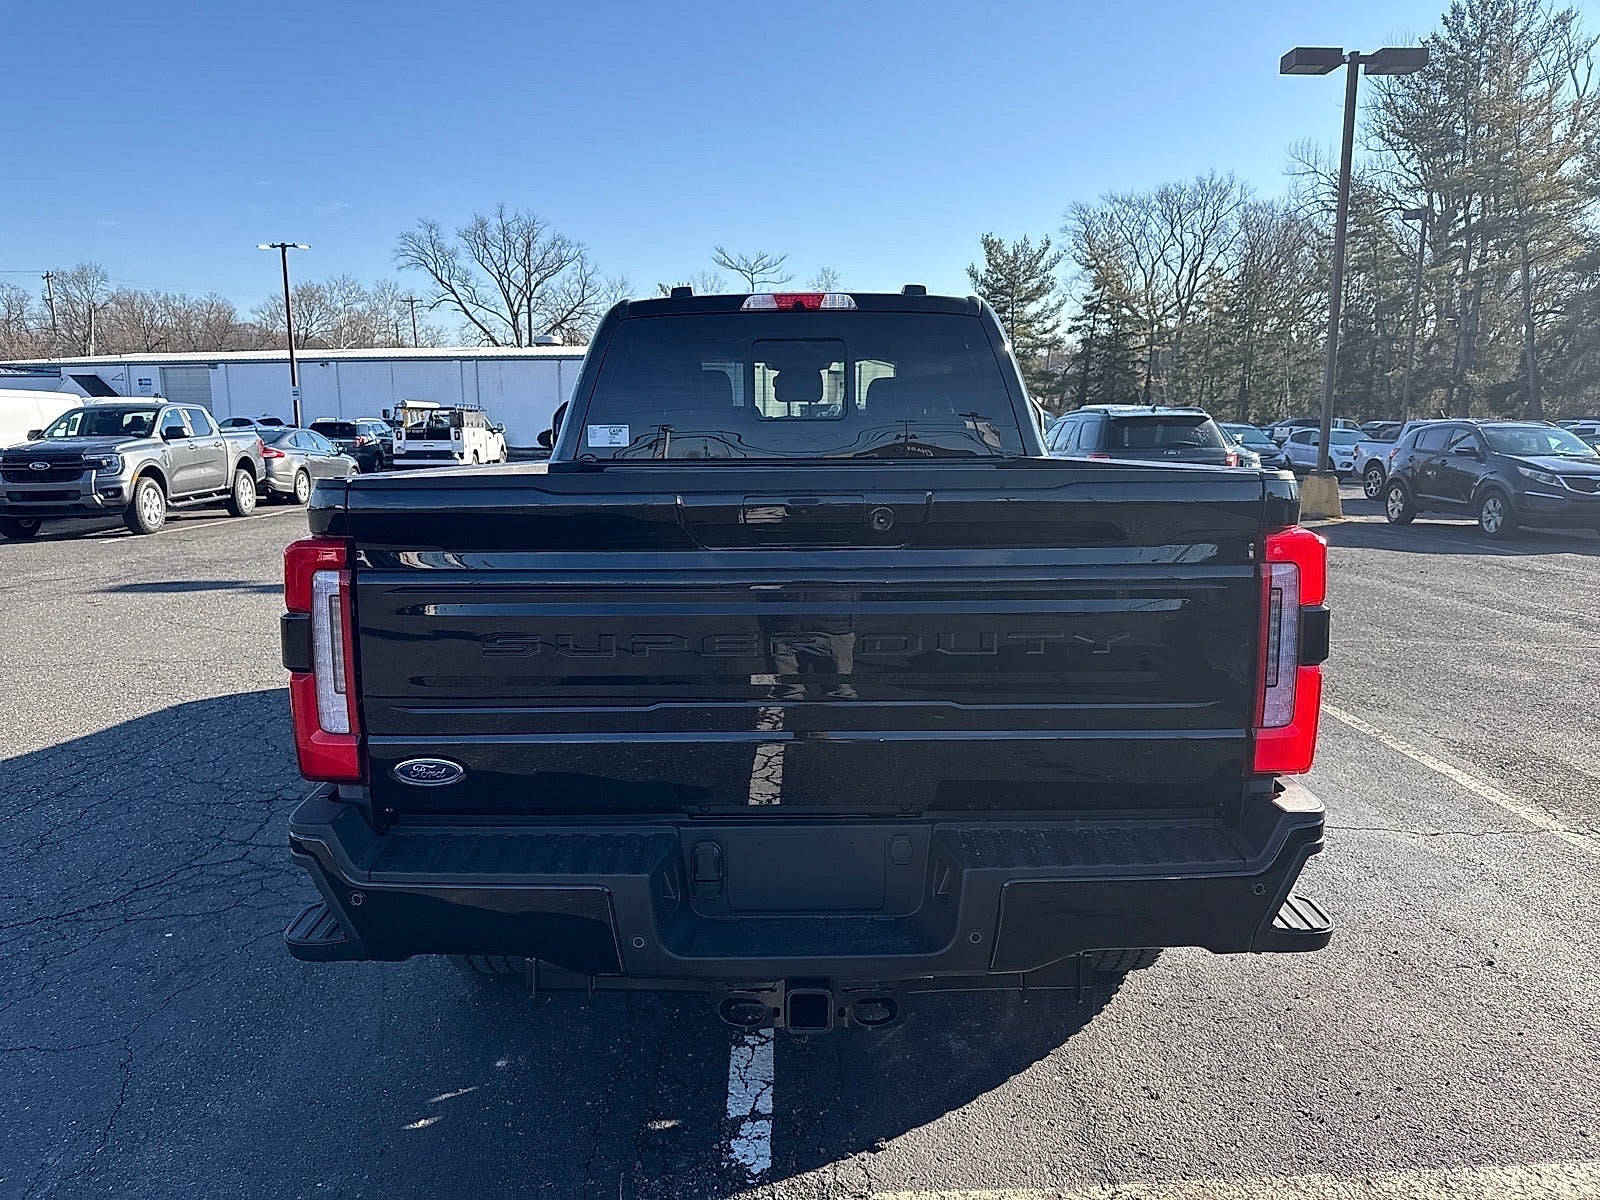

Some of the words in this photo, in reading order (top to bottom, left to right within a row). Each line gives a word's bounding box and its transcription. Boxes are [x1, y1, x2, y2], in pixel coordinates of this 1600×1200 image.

[481, 633, 831, 658] SUPER
[861, 632, 1132, 656] DUTY
[410, 763, 447, 778] Ford
